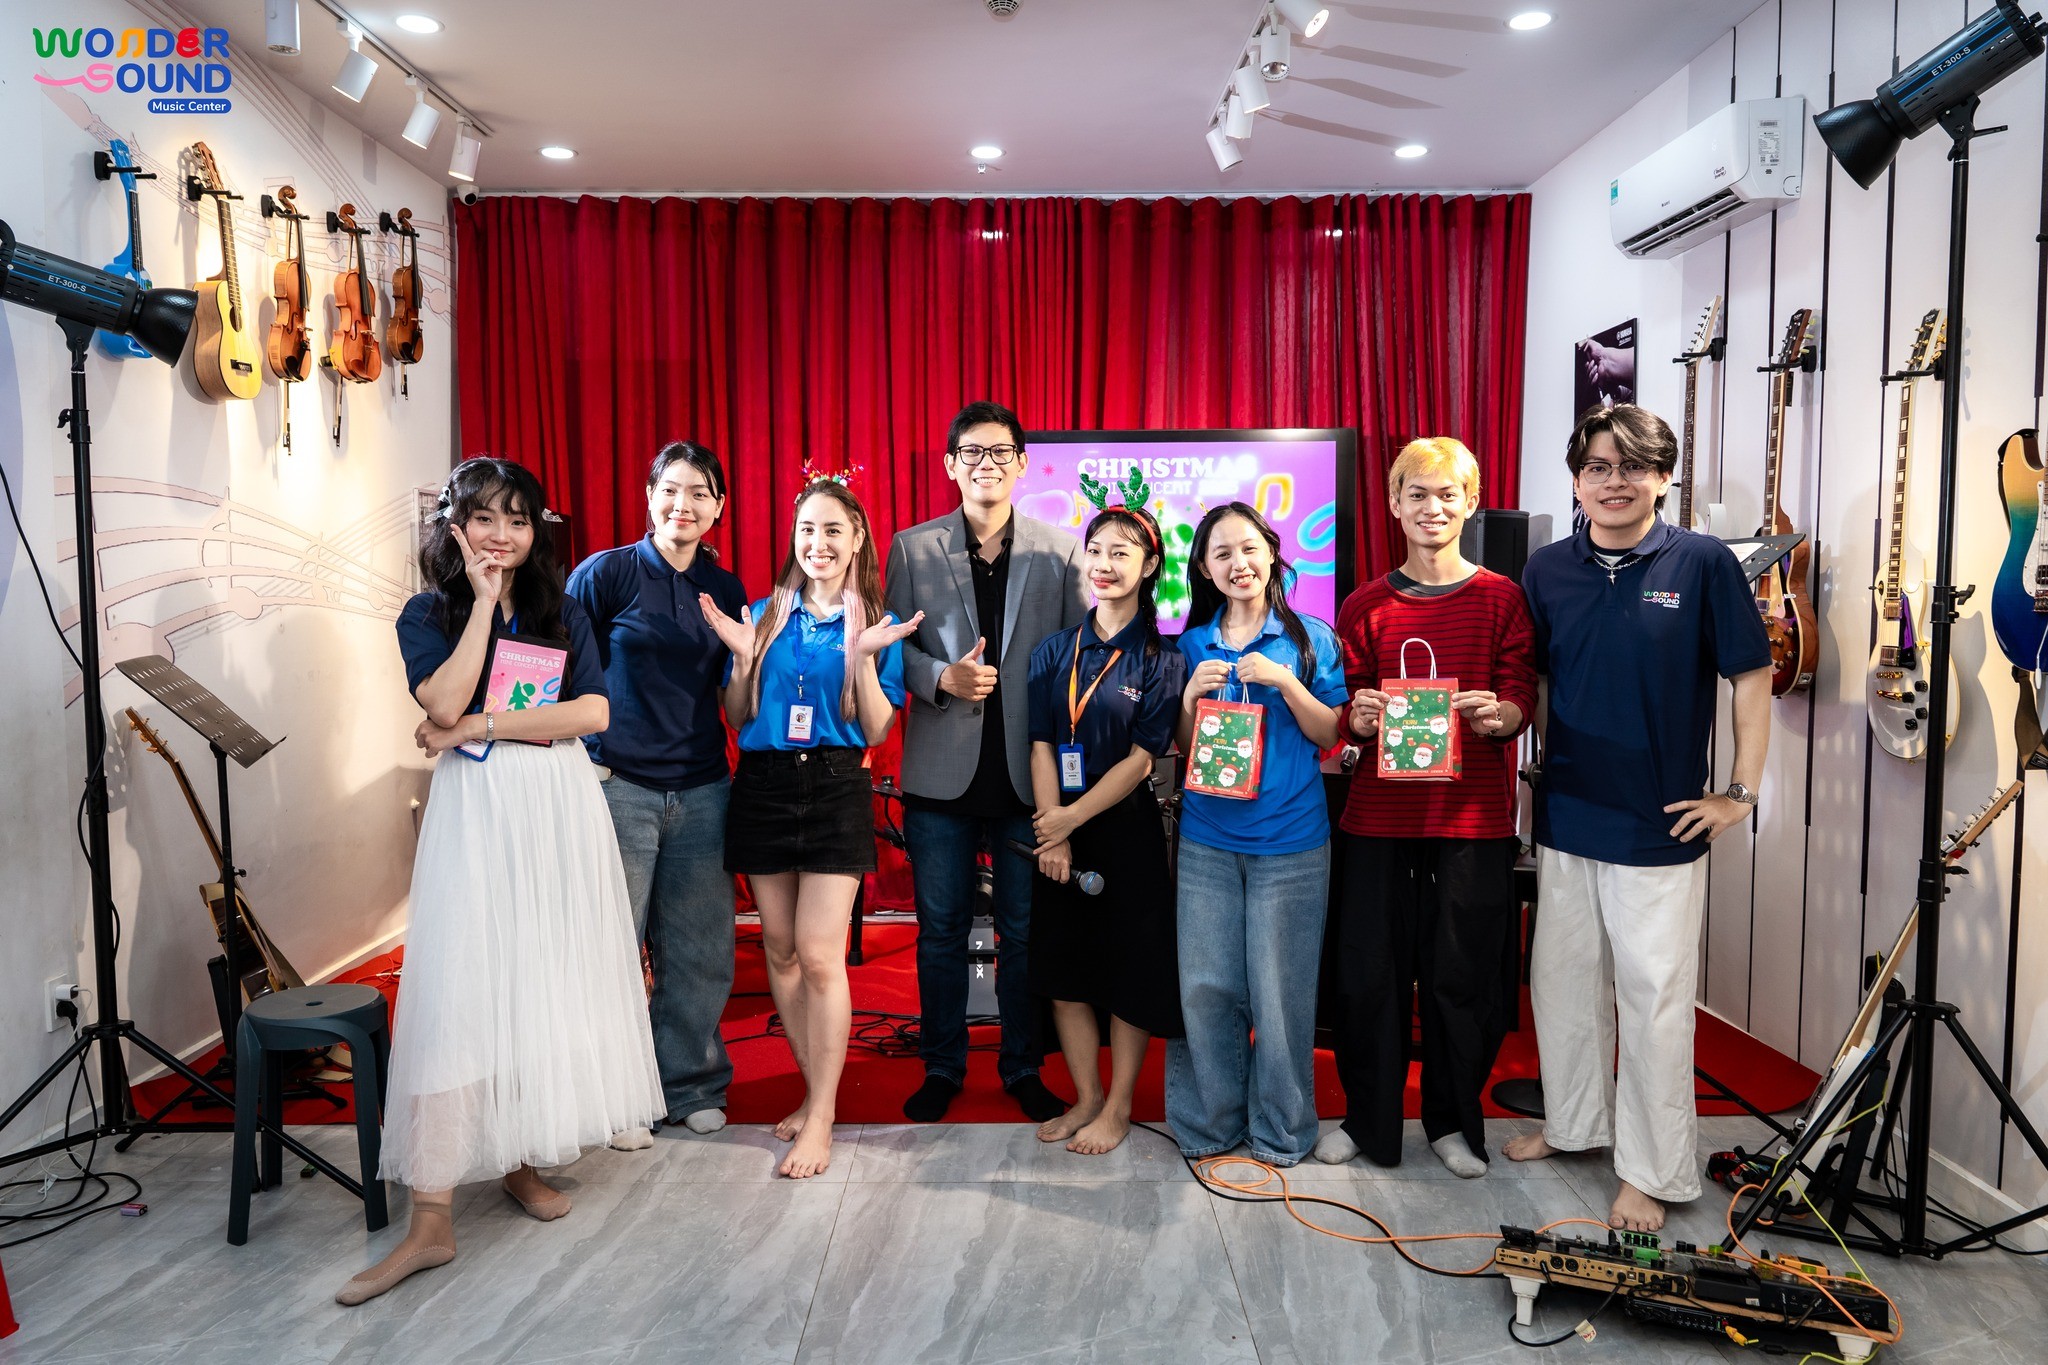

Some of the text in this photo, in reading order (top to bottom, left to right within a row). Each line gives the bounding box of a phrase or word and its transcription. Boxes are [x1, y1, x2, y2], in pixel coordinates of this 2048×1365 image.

[1932, 46, 1971, 76] ET-300-S
[48, 274, 87, 293] ET-300-S
[1643, 591, 1680, 599] WONDER
[500, 651, 560, 668] CHRISTMAS
